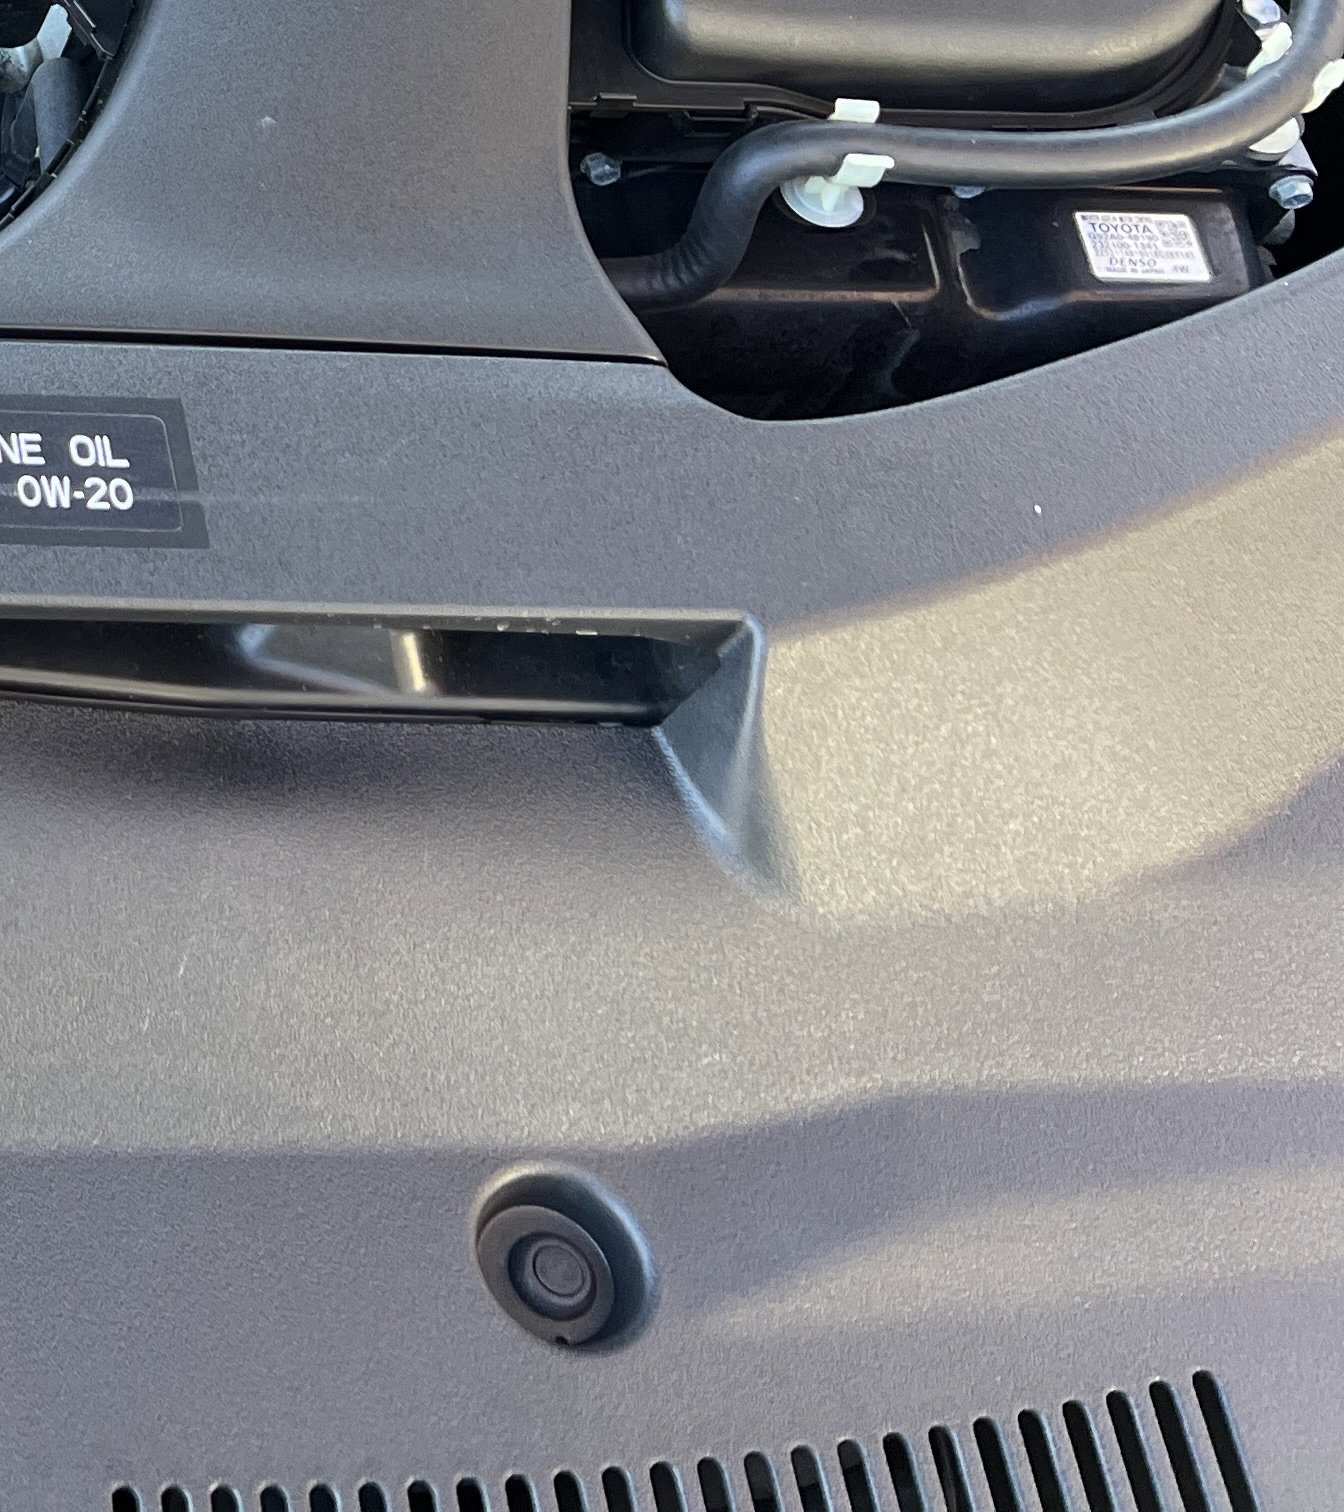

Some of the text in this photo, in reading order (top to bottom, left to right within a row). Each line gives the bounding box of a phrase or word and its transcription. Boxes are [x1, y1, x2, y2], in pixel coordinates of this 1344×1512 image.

[1089, 222, 1153, 234] TOYOTA
[1109, 257, 1157, 268] DENSO
[69, 434, 130, 468] OIL
[15, 474, 135, 511] 0W-20
